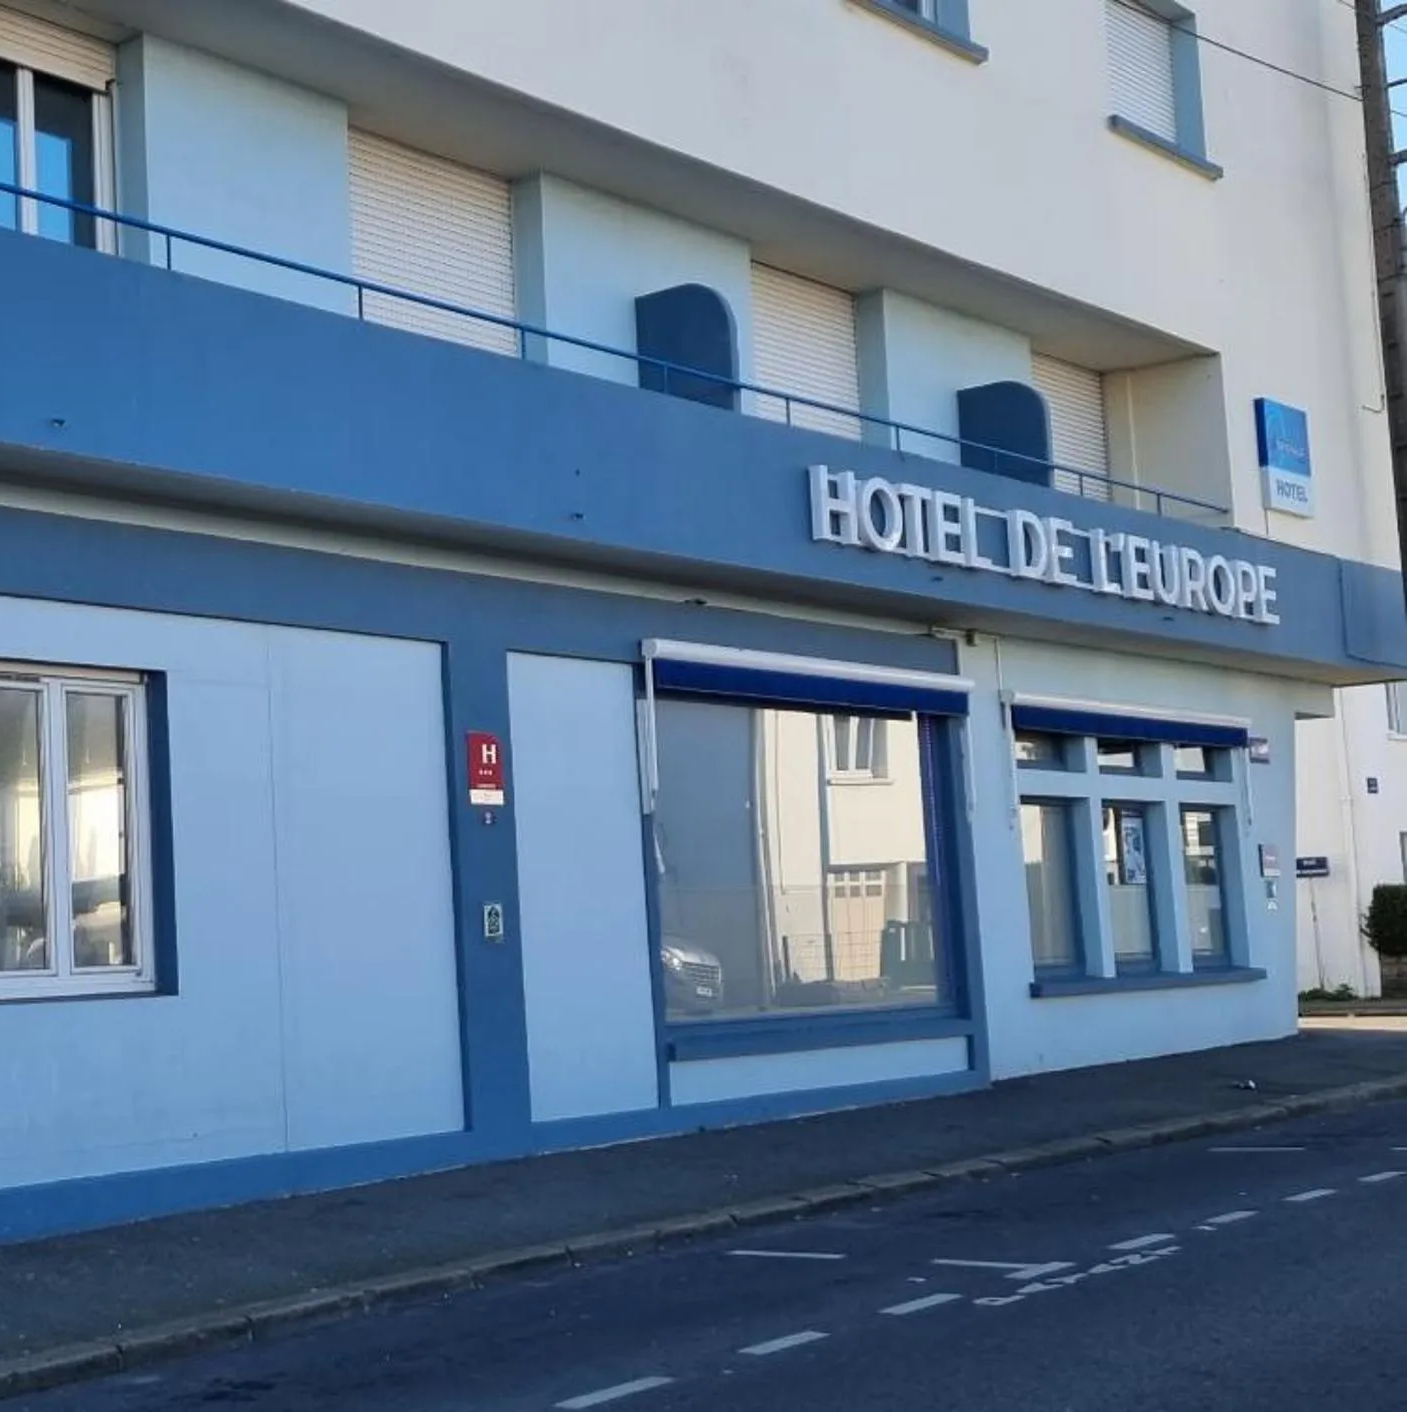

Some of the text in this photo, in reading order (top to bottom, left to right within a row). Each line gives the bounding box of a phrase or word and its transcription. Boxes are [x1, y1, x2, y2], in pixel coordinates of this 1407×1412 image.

[808, 464, 1281, 625] HOTEL DE L'EUROPE
[481, 743, 497, 765] H
